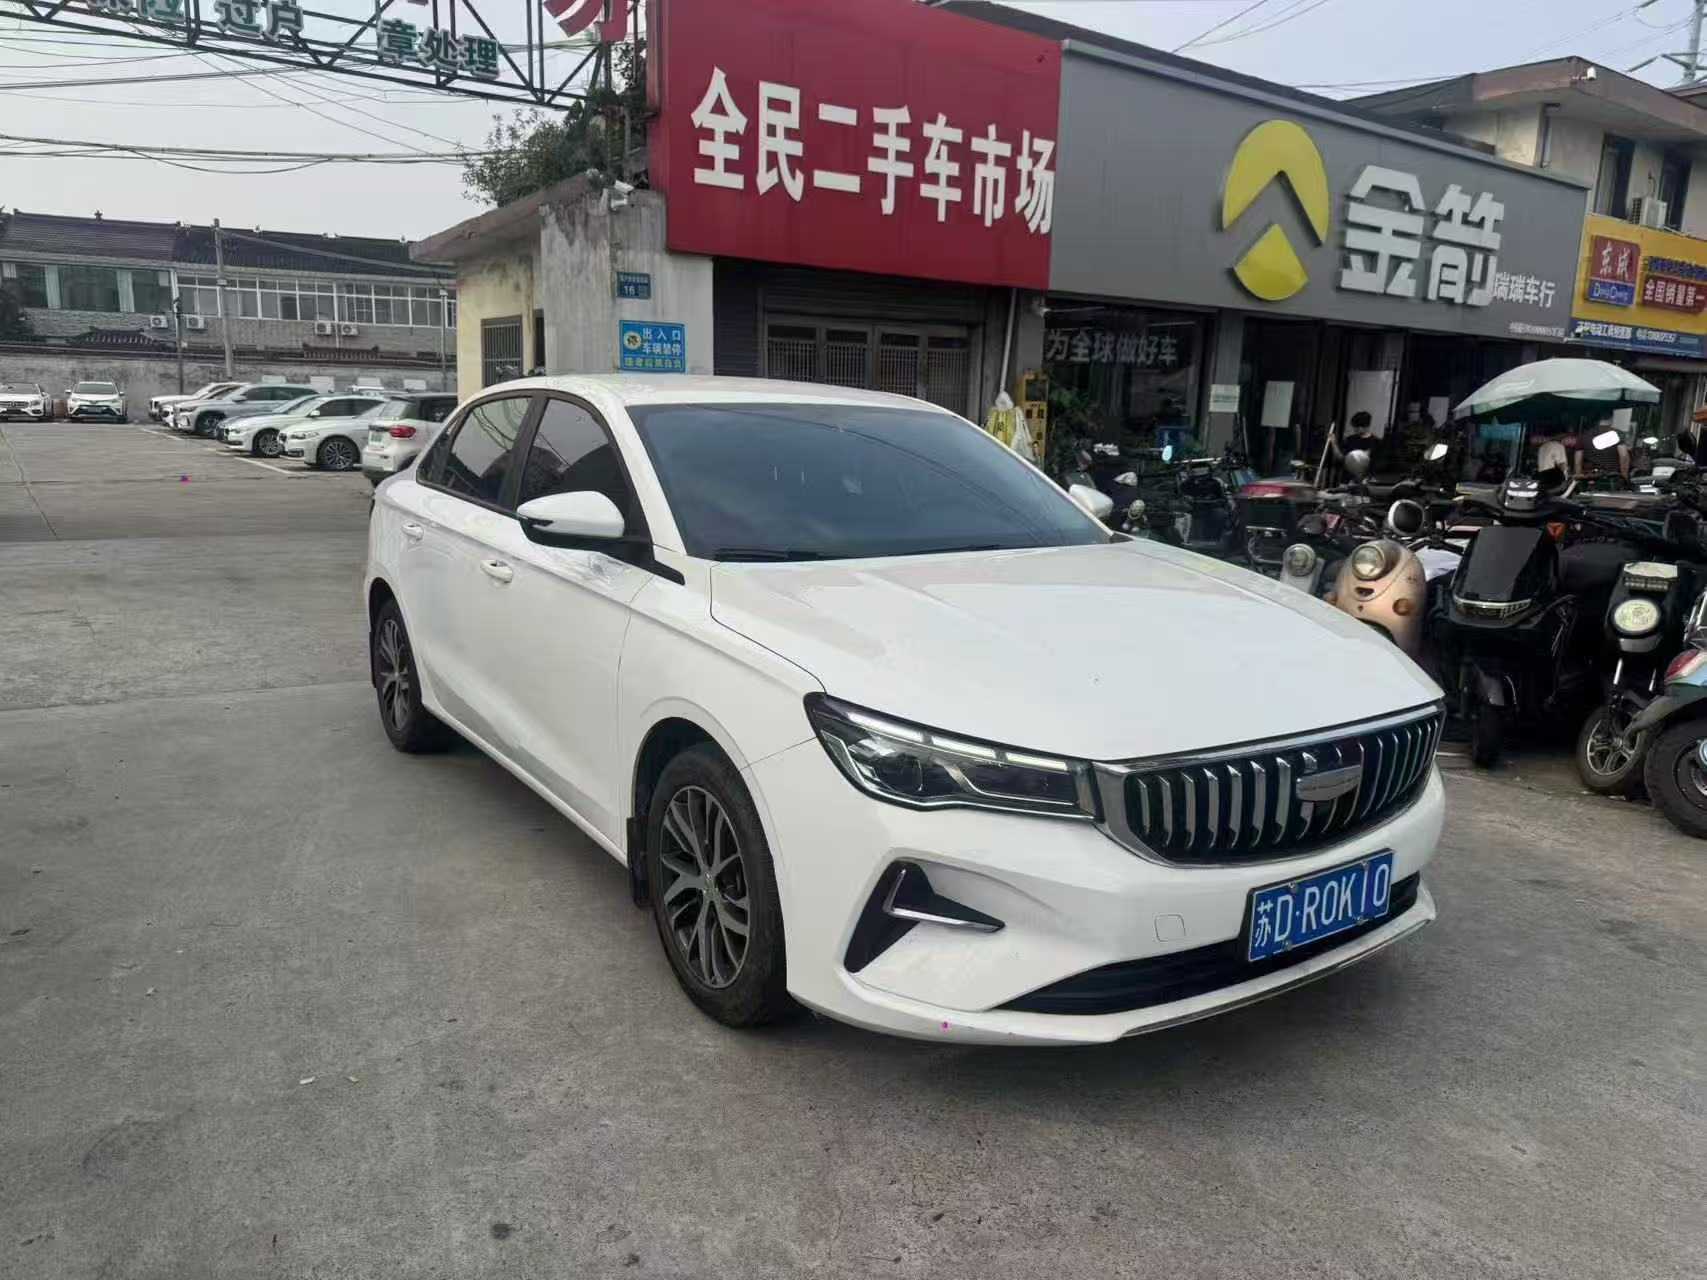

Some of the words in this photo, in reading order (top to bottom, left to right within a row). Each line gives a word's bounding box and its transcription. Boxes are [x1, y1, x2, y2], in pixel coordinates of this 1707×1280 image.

[377, 18, 499, 79] 章处理
[690, 65, 1056, 234] 全民二手车市场
[1340, 164, 1504, 307] 金箭
[1494, 272, 1556, 308] 瑞瑞车行
[1644, 279, 1705, 307] 全国销量第一
[642, 327, 681, 341] 出入口
[1044, 329, 1178, 366] 为全球做好车
